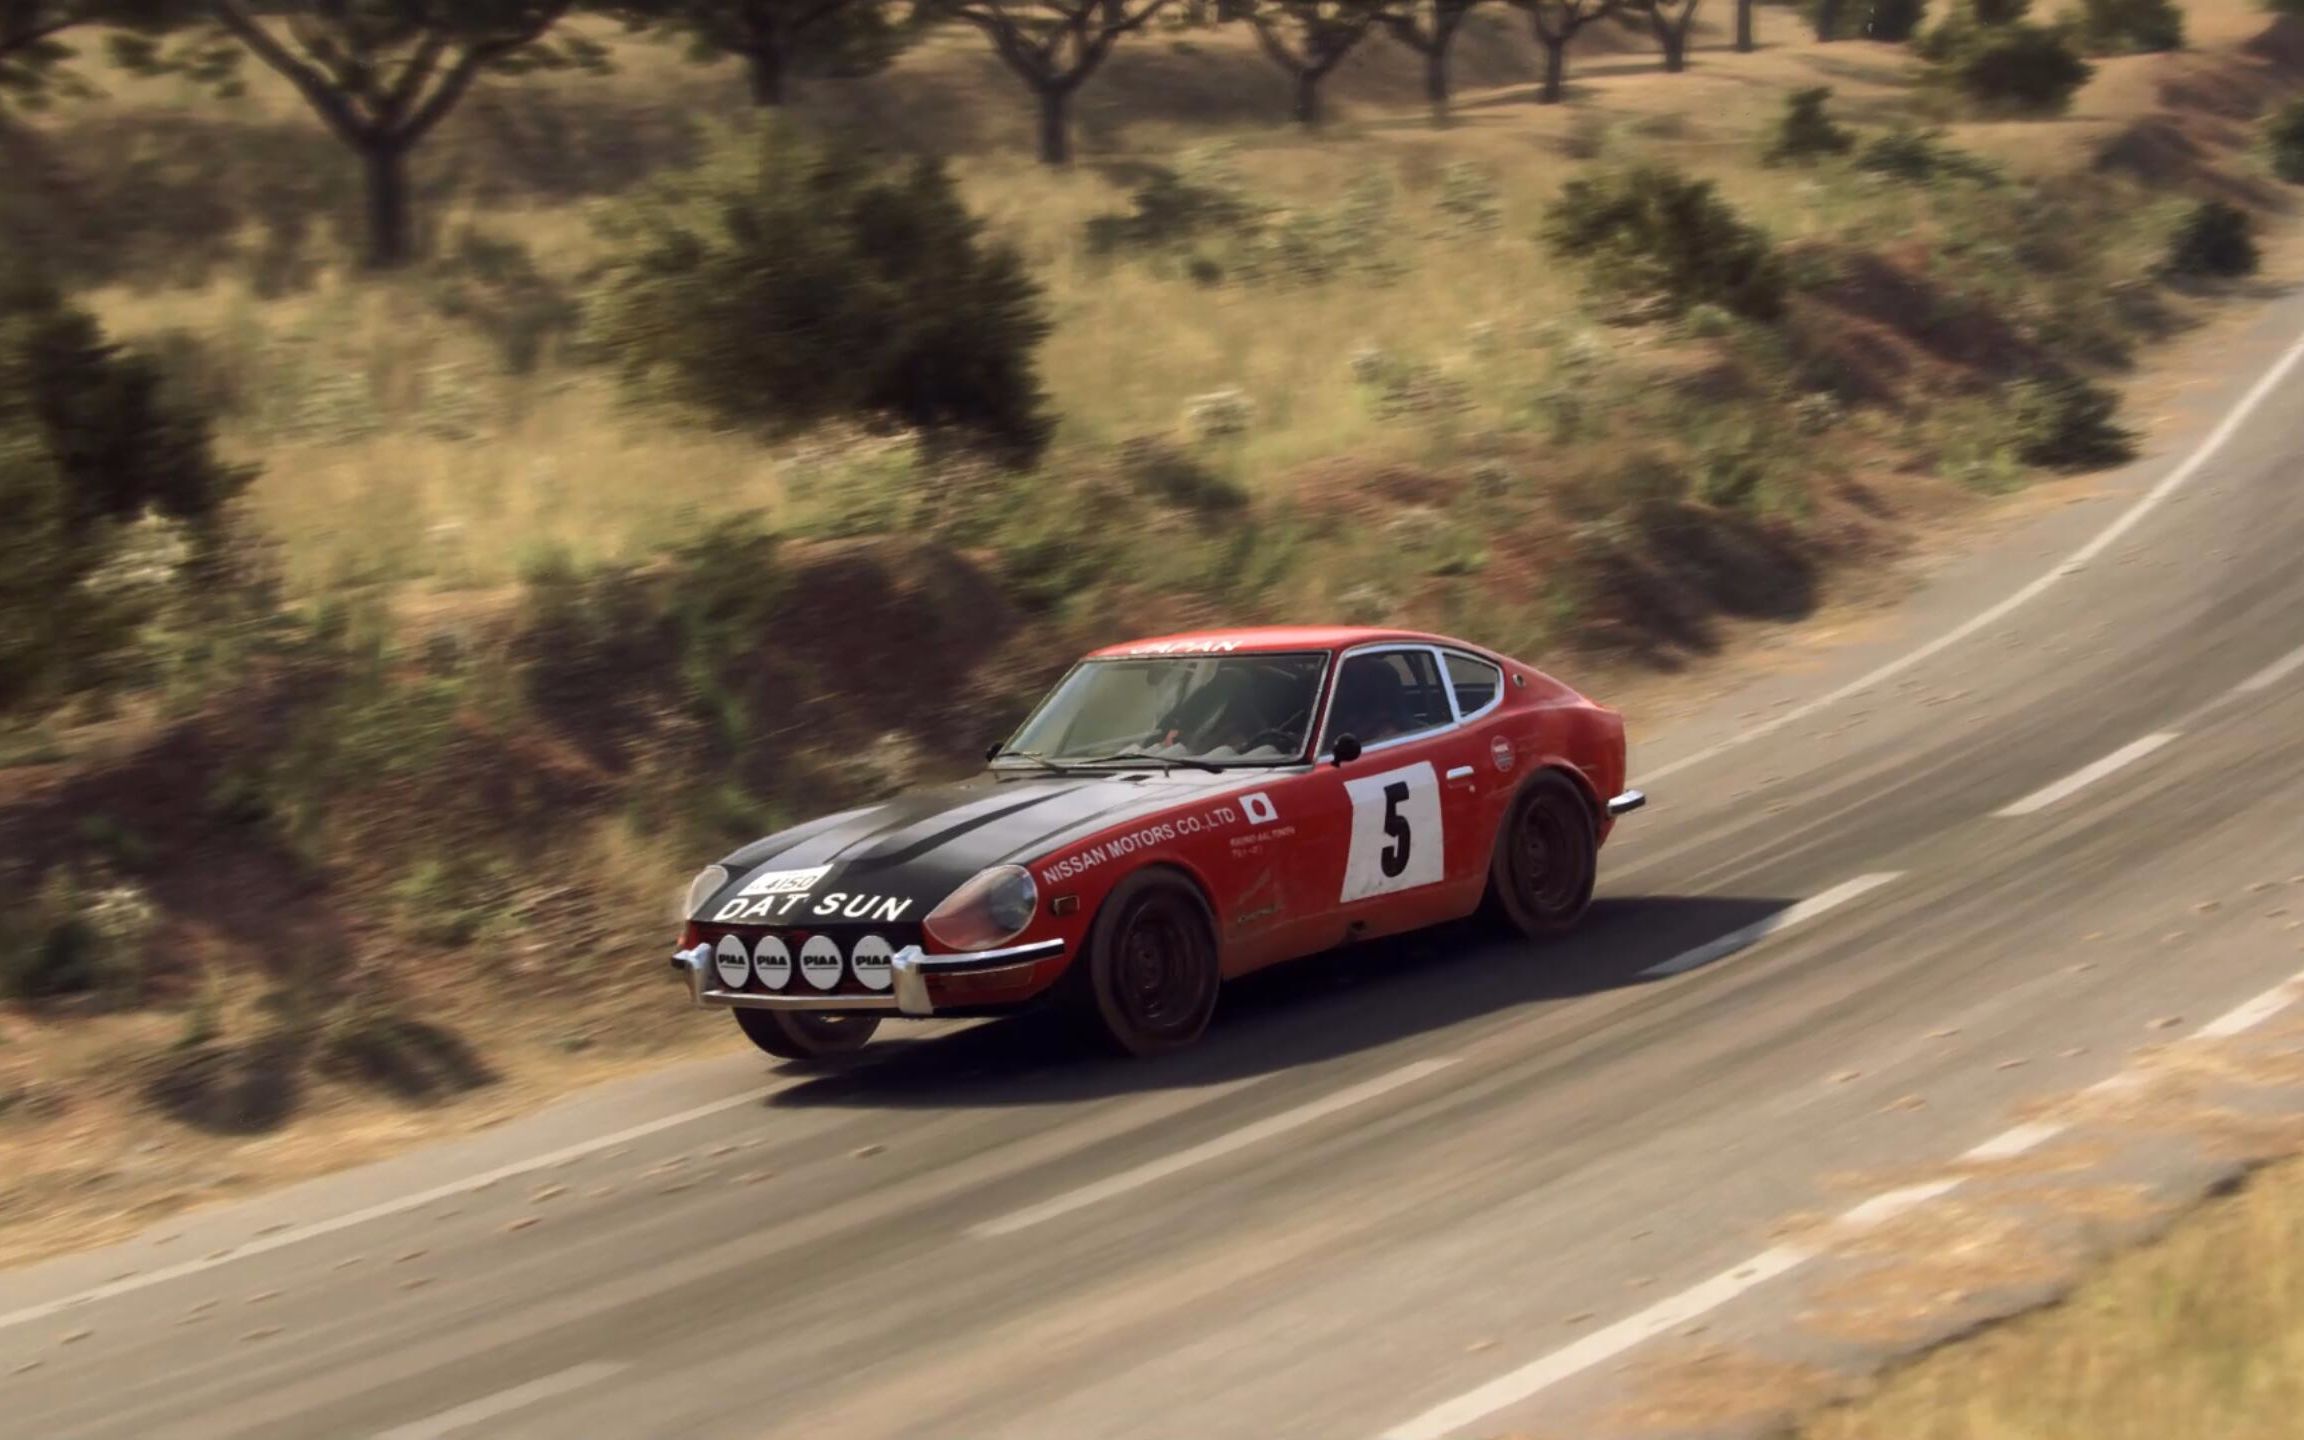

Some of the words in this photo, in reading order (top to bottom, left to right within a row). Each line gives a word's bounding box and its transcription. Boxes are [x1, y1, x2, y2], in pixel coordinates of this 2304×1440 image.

[1380, 780, 1412, 878] 5
[1042, 846, 1107, 885] NISSAN
[1106, 823, 1175, 859] MOTORS
[718, 954, 746, 965] PIAA
[757, 955, 788, 966] PIAA
[803, 955, 839, 966] PIAA
[856, 955, 892, 966] PIAA
